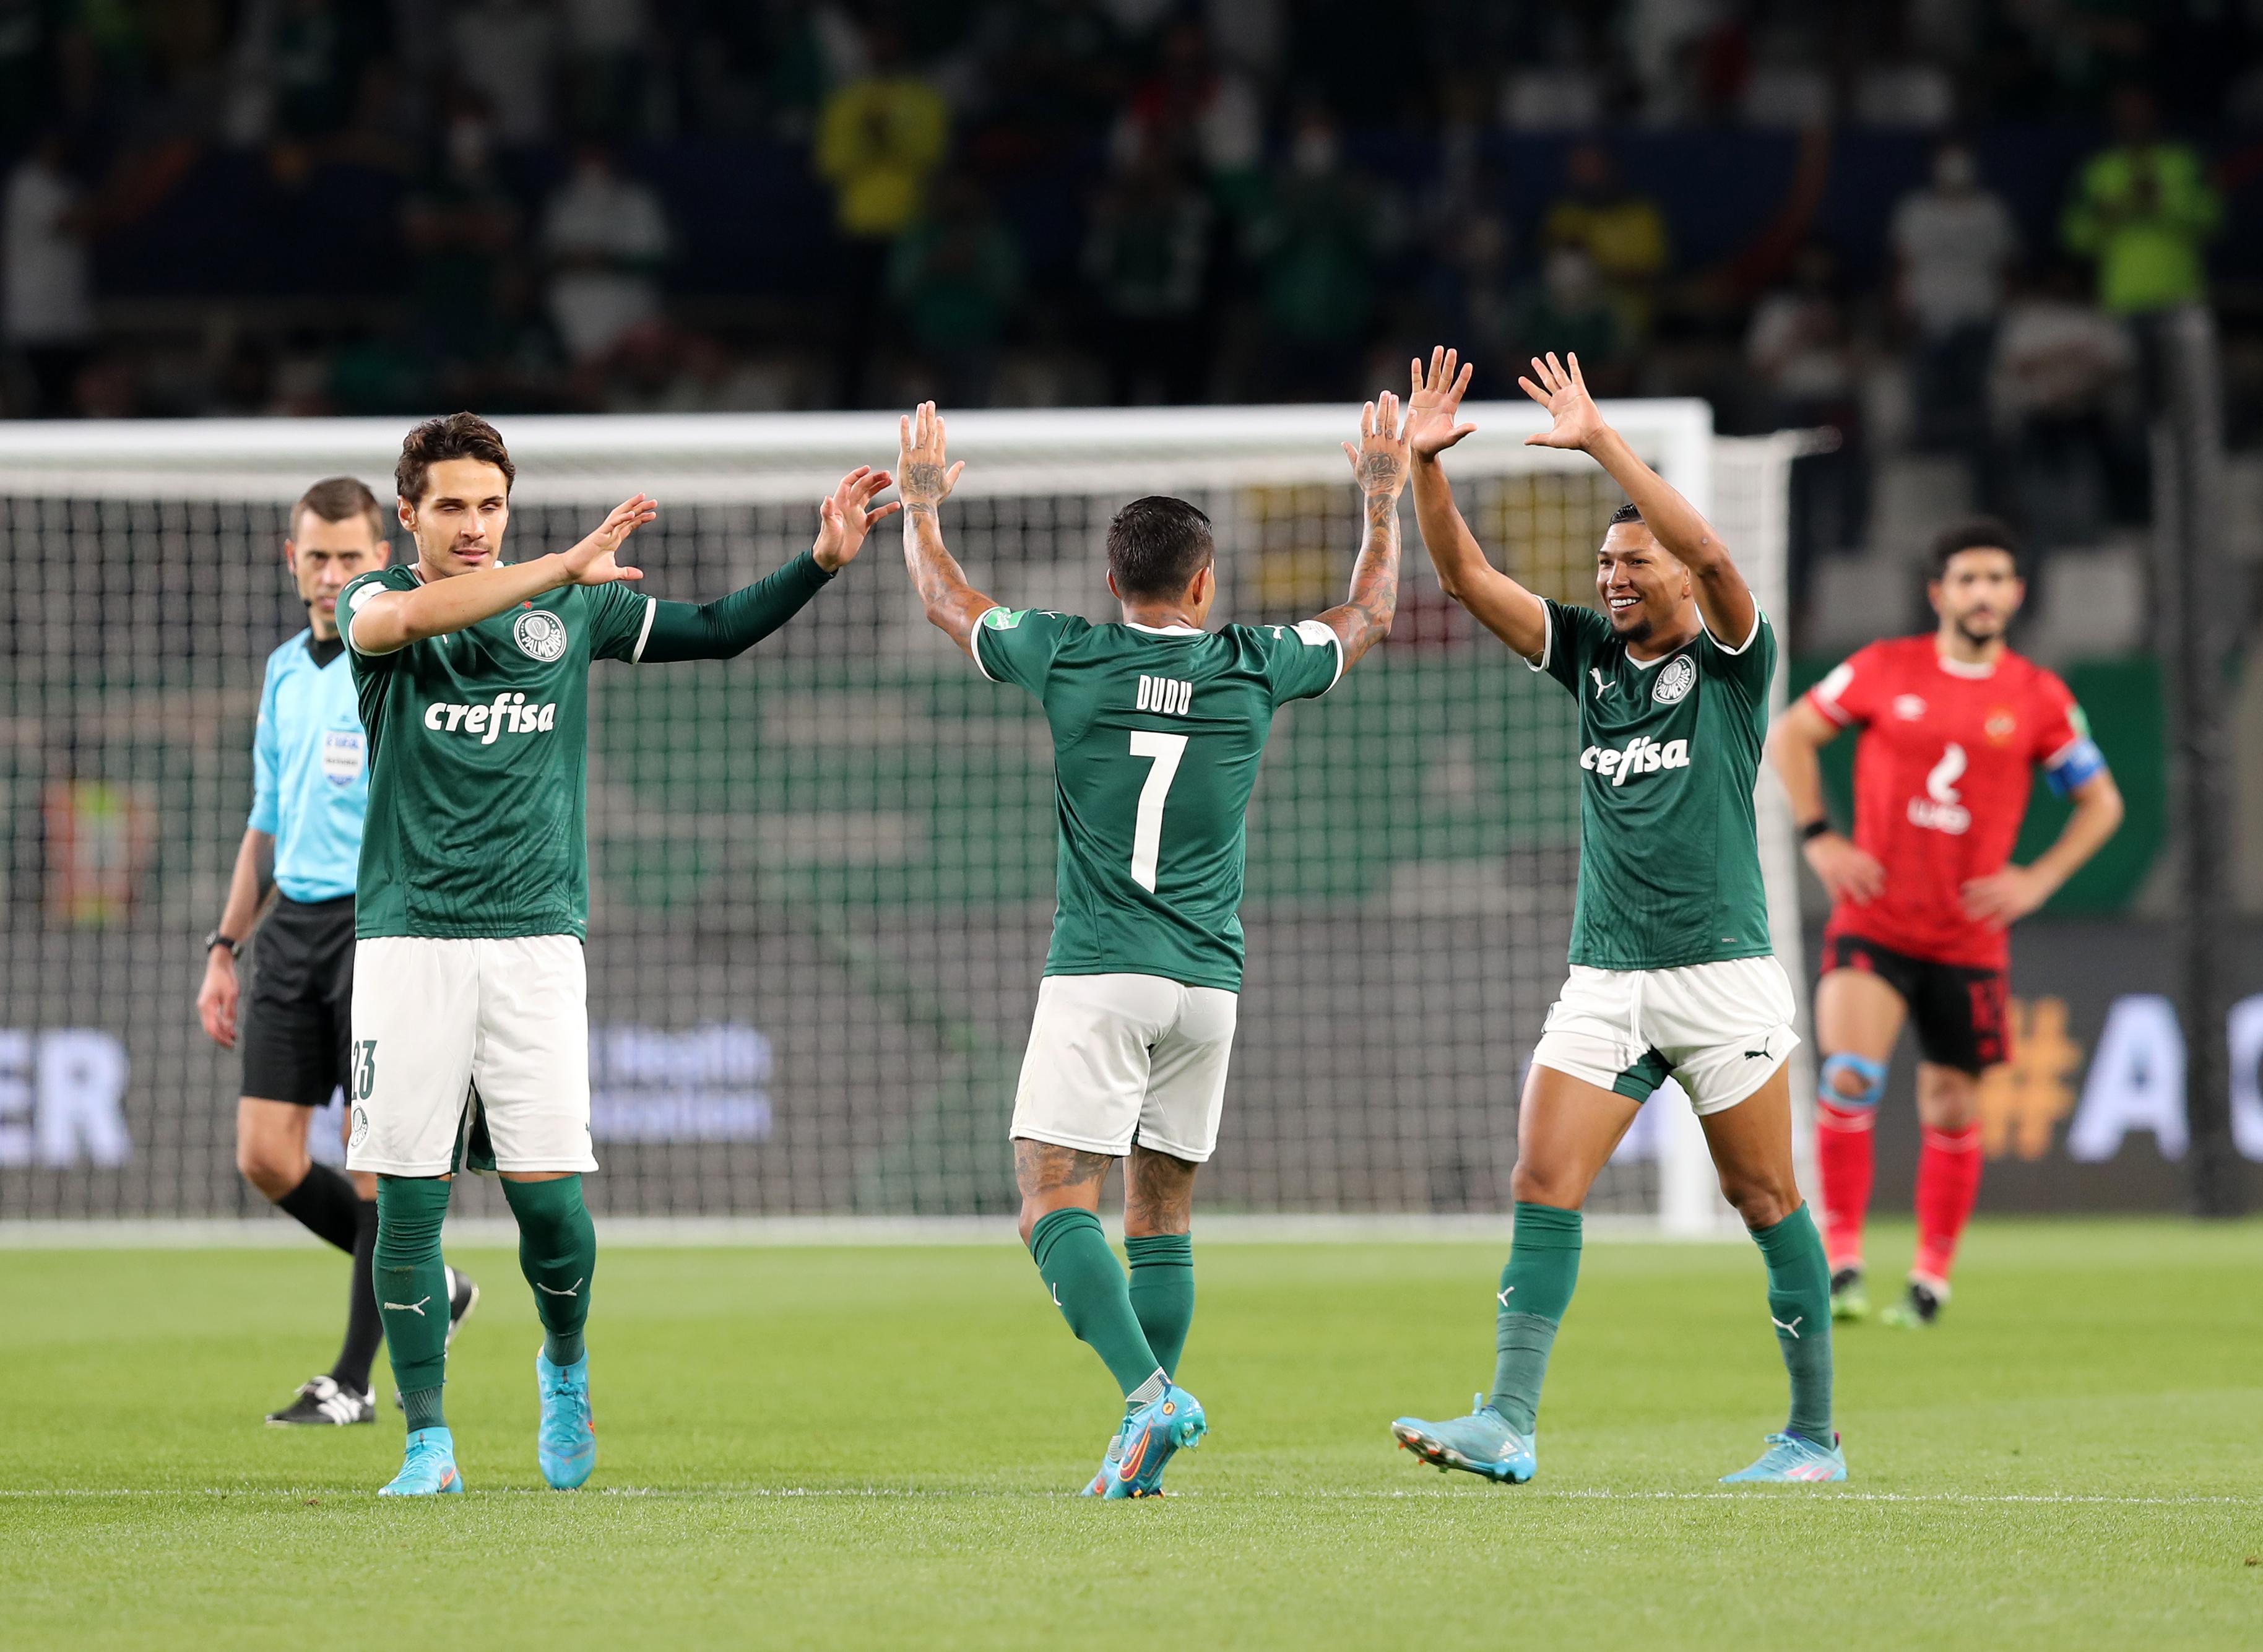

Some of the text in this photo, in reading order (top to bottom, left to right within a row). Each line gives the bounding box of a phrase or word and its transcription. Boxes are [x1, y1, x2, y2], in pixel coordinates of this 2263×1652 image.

[522, 628, 561, 657] PALMEIRAS
[1136, 674, 1193, 716] DUDU
[1656, 668, 1690, 699] PALMEIRAS
[424, 692, 556, 745] crefisa
[1129, 730, 1189, 894] 7
[352, 1040, 378, 1100] 23
